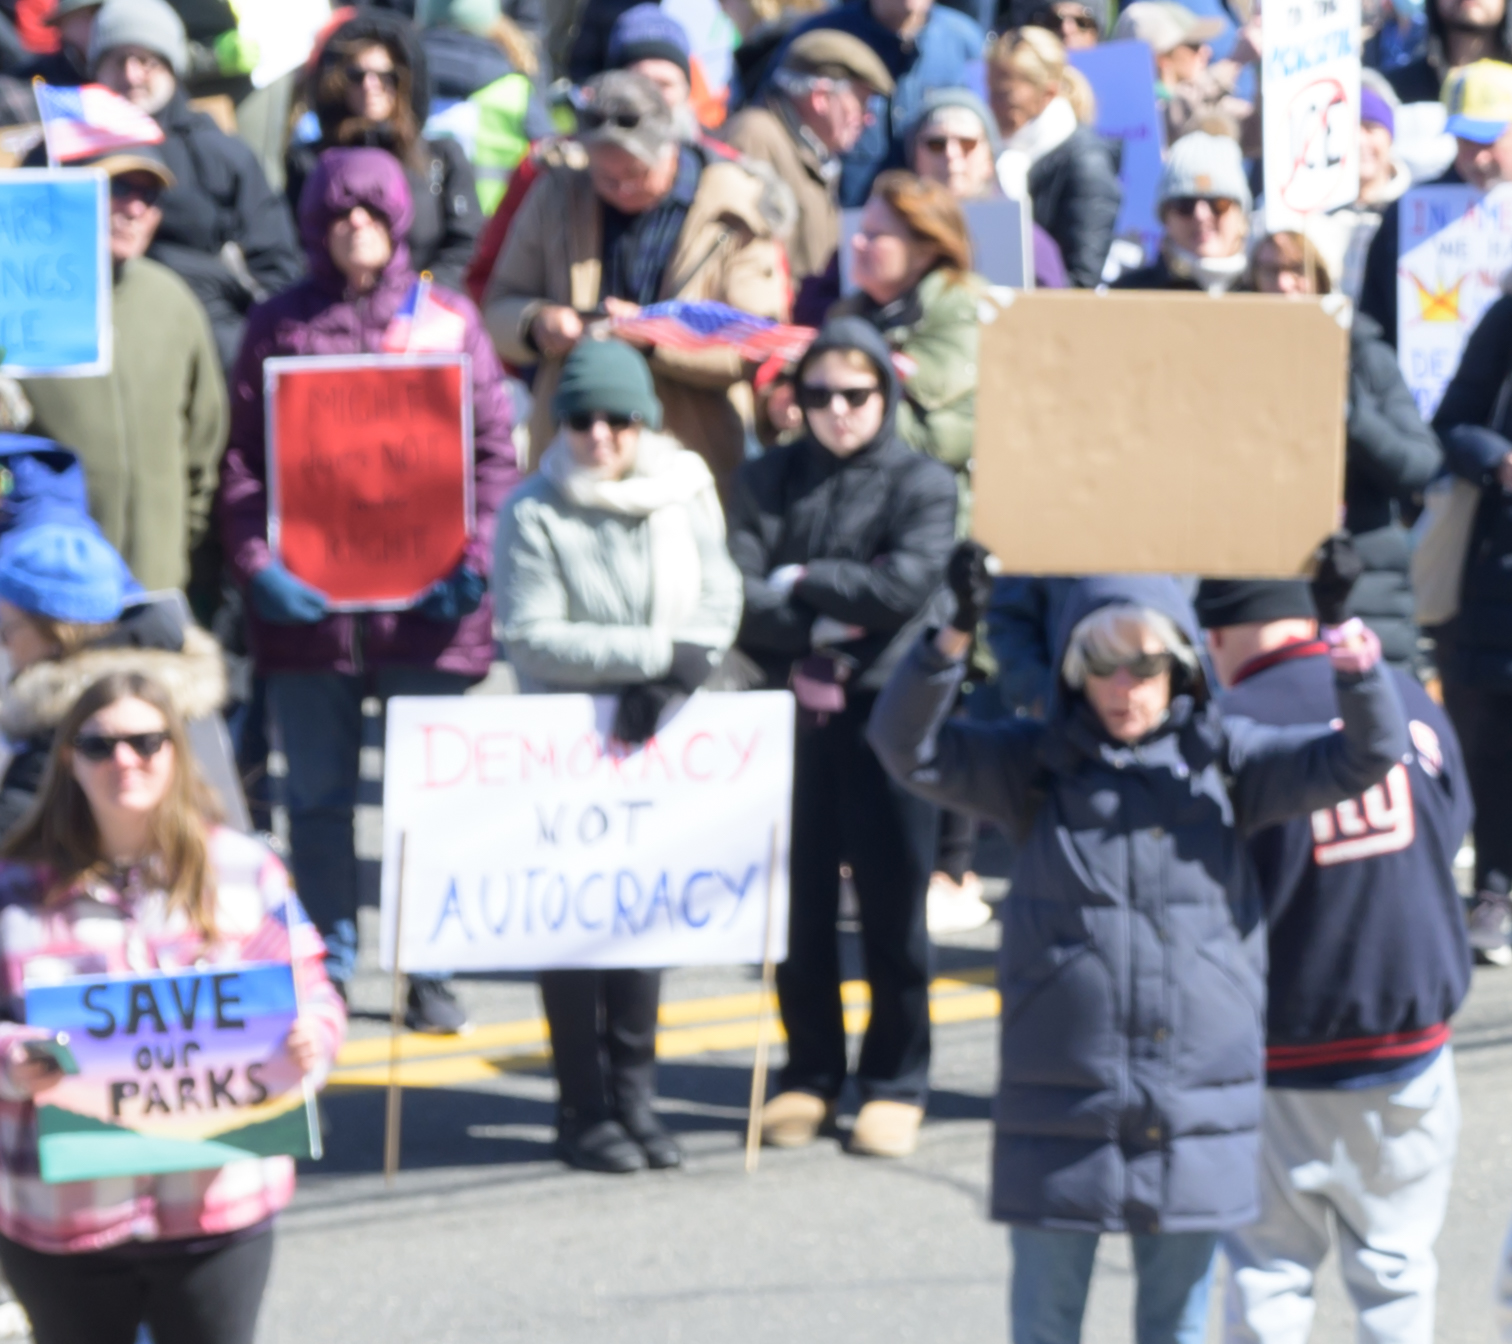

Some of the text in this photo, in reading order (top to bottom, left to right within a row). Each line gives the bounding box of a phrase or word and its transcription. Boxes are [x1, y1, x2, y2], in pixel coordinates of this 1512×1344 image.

[536, 799, 654, 848] NOT
[428, 862, 760, 946] AUTOCRACY
[81, 970, 248, 1041] SAVE
[108, 1061, 272, 1121] PARKS
